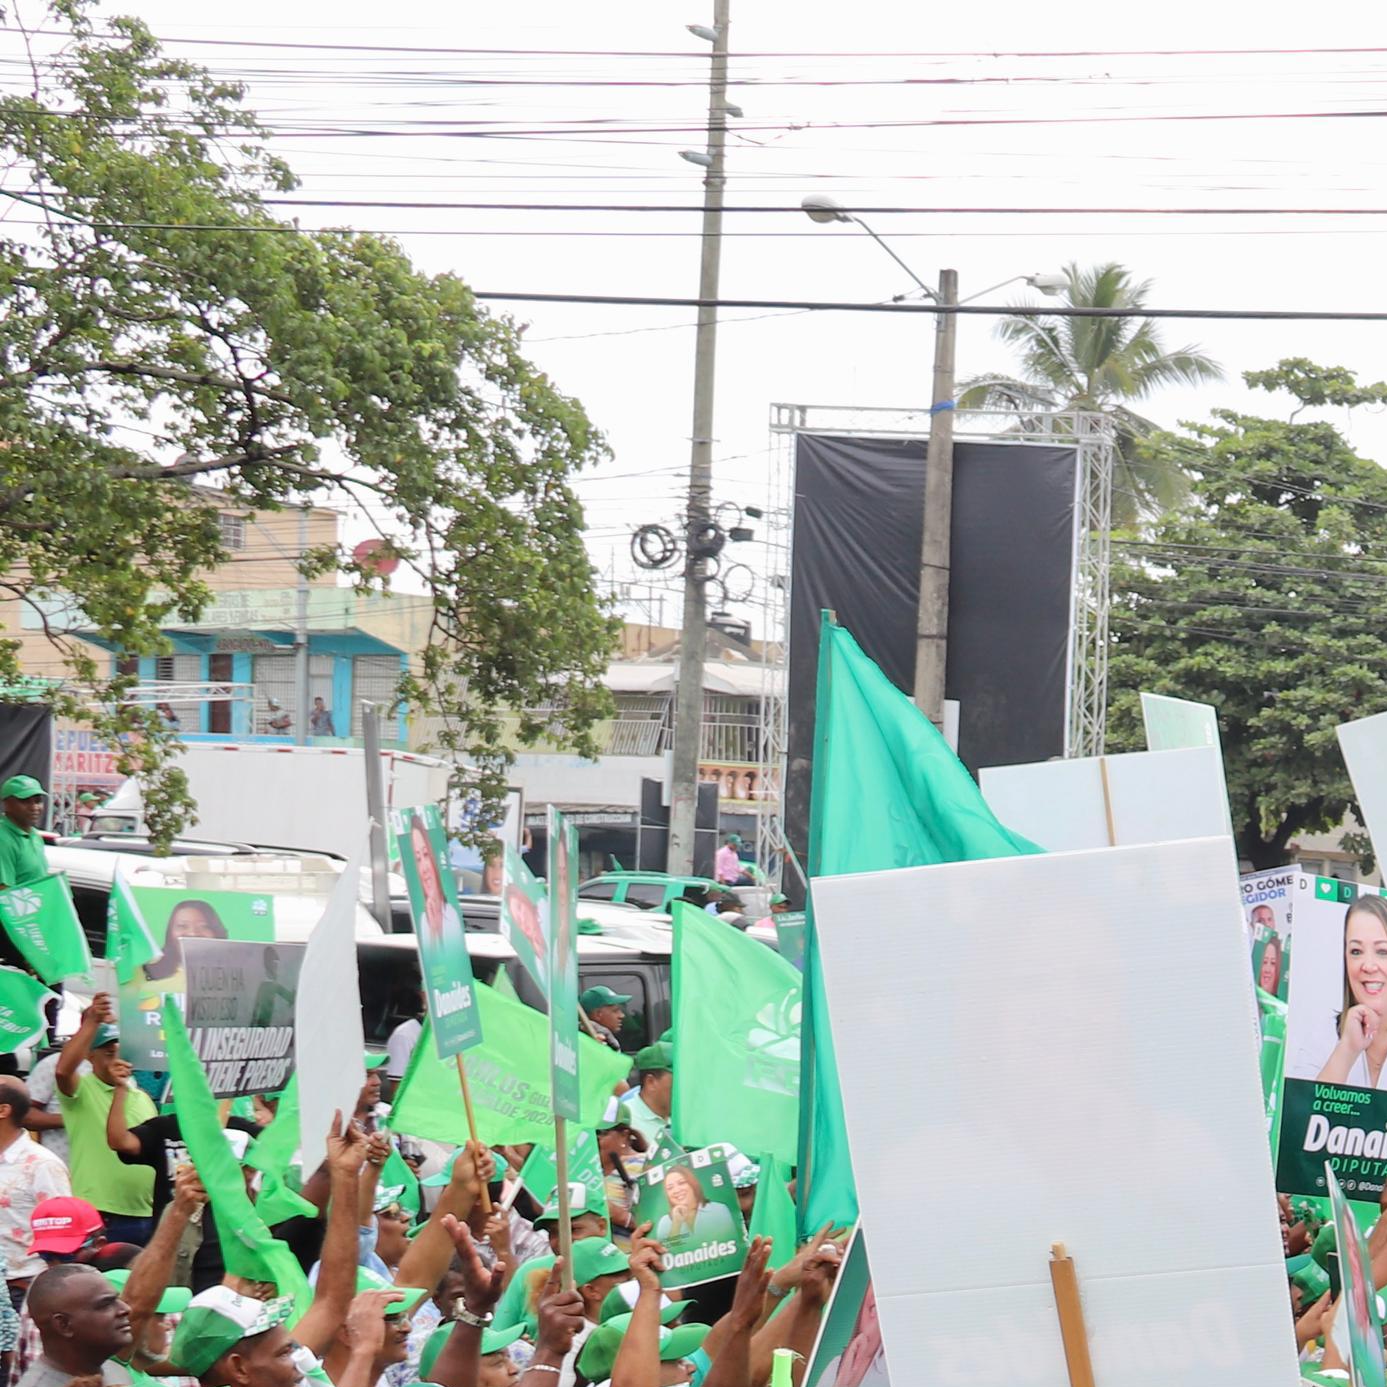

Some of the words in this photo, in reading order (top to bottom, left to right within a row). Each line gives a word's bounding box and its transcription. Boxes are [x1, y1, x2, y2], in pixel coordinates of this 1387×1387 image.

[1257, 875, 1294, 891] GÓME
[202, 1027, 293, 1060] INSEGURIDAD
[239, 1058, 291, 1090] PRESOS
[1313, 1100, 1322, 1111] a
[1315, 1084, 1372, 1104] Volvamos
[662, 1240, 736, 1270] Danaides
